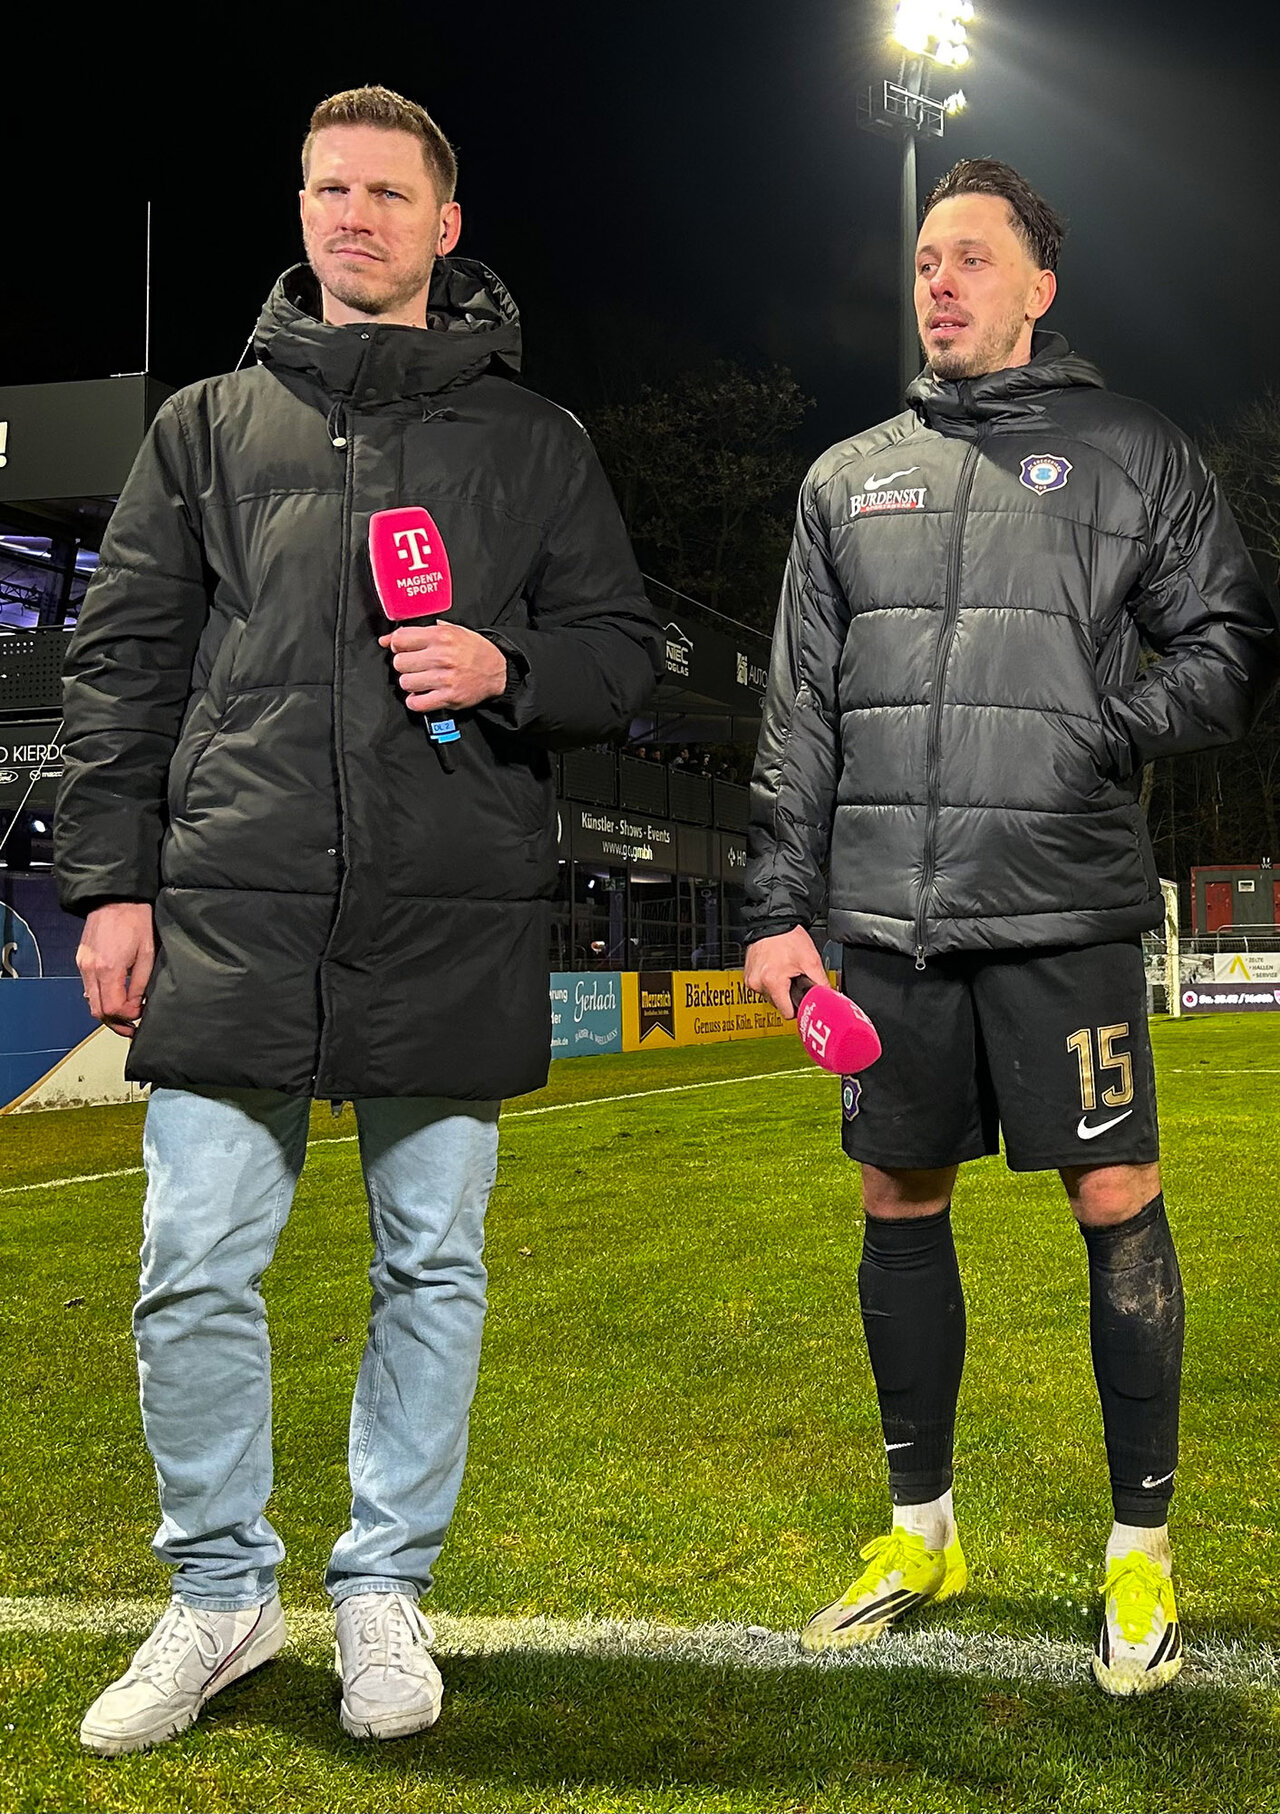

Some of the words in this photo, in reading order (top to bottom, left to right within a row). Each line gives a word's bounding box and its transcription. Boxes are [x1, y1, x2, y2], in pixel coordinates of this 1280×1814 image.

[850, 487, 927, 518] BURDENSKI
[393, 528, 432, 571] T
[396, 571, 444, 589] MAGENTA
[406, 582, 438, 597] SPORT
[581, 811, 615, 834] Künstler
[619, 819, 642, 839] Shows
[647, 825, 670, 843] Events
[573, 980, 617, 1023] Gerlach
[685, 981, 735, 1008] Bäckerei
[736, 981, 768, 1005] Merz
[694, 1017, 721, 1034] Genuss
[721, 1018, 735, 1031] aus
[735, 1014, 754, 1031] Köln.
[1066, 1022, 1134, 1111] 15
